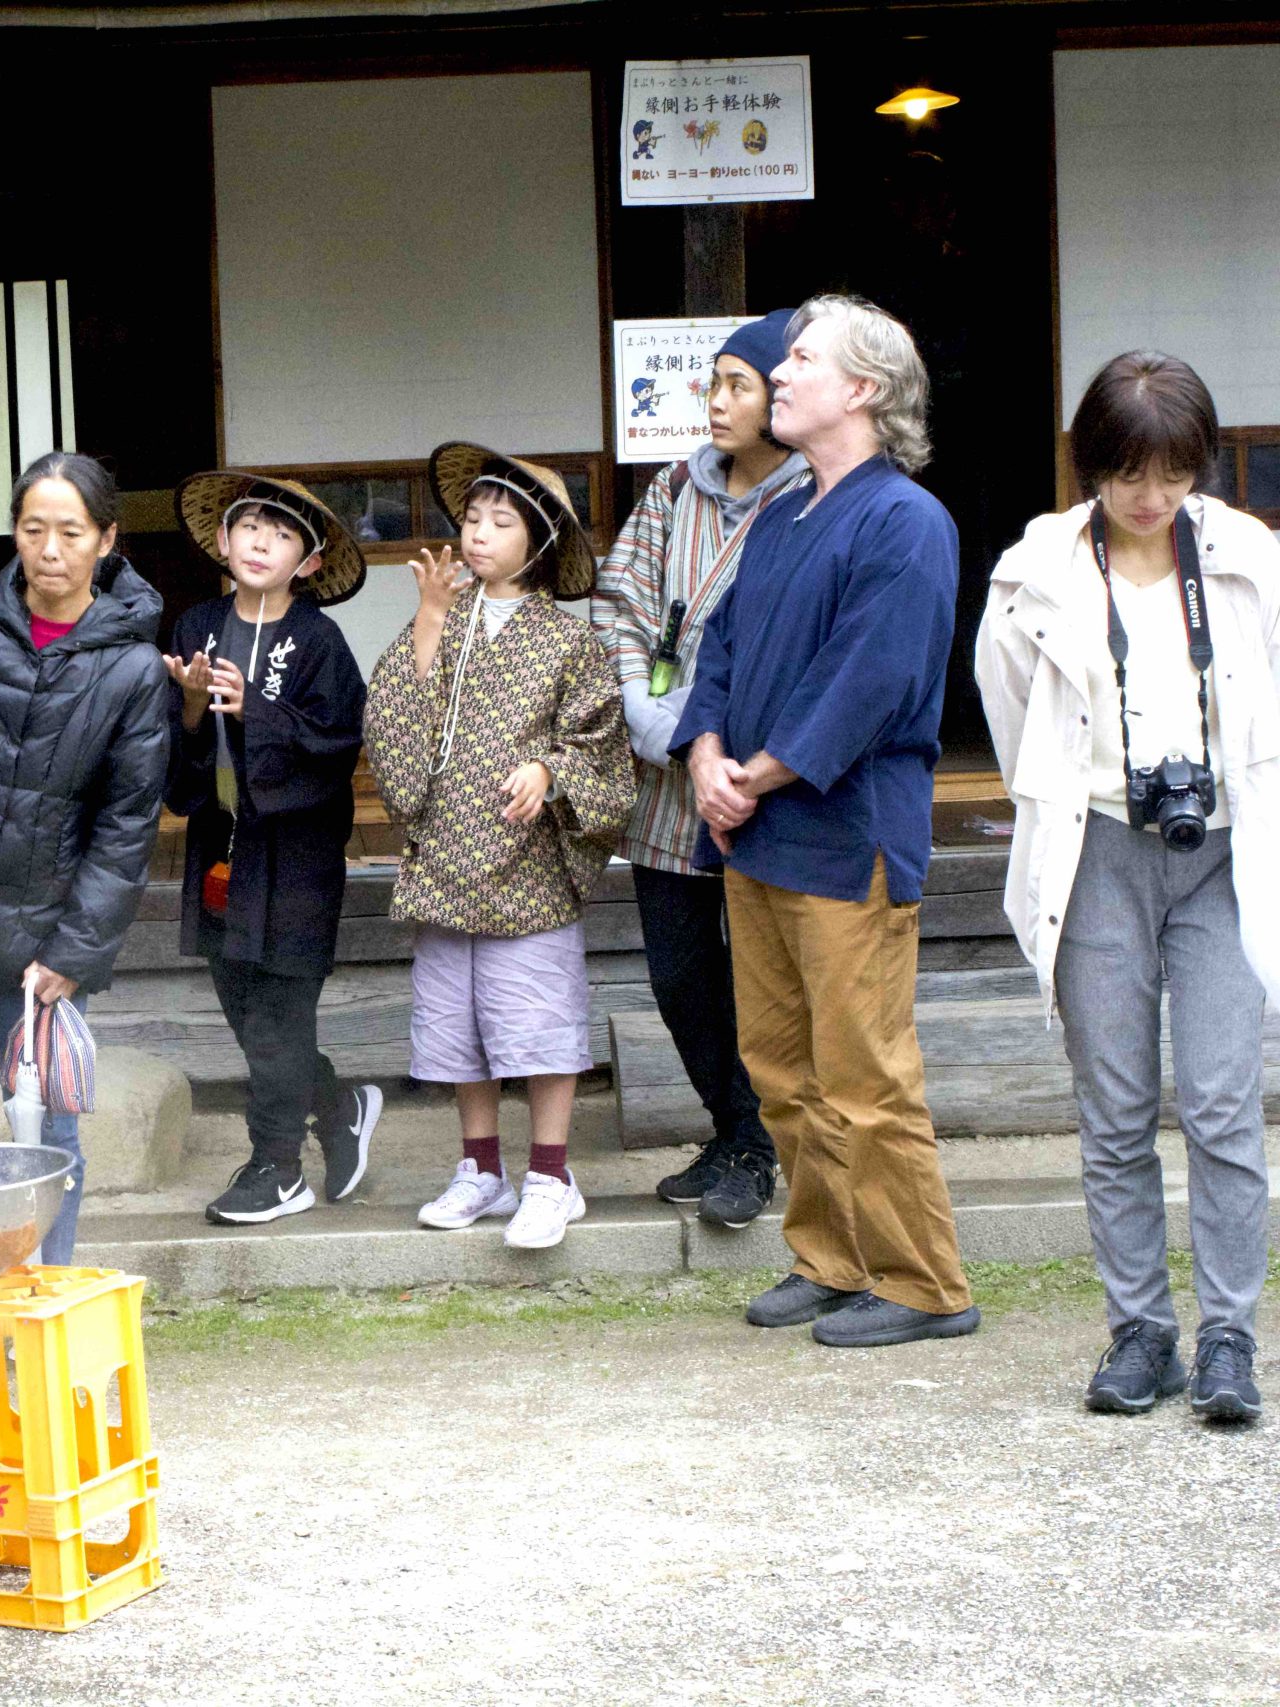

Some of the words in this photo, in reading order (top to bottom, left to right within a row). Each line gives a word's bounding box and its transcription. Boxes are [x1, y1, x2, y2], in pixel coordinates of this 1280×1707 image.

[633, 75, 749, 88] まぶりっとさんと一緒に
[645, 91, 782, 115] 縁側お手軽体験
[1185, 578, 1201, 628] Canon
[261, 636, 296, 701] せき
